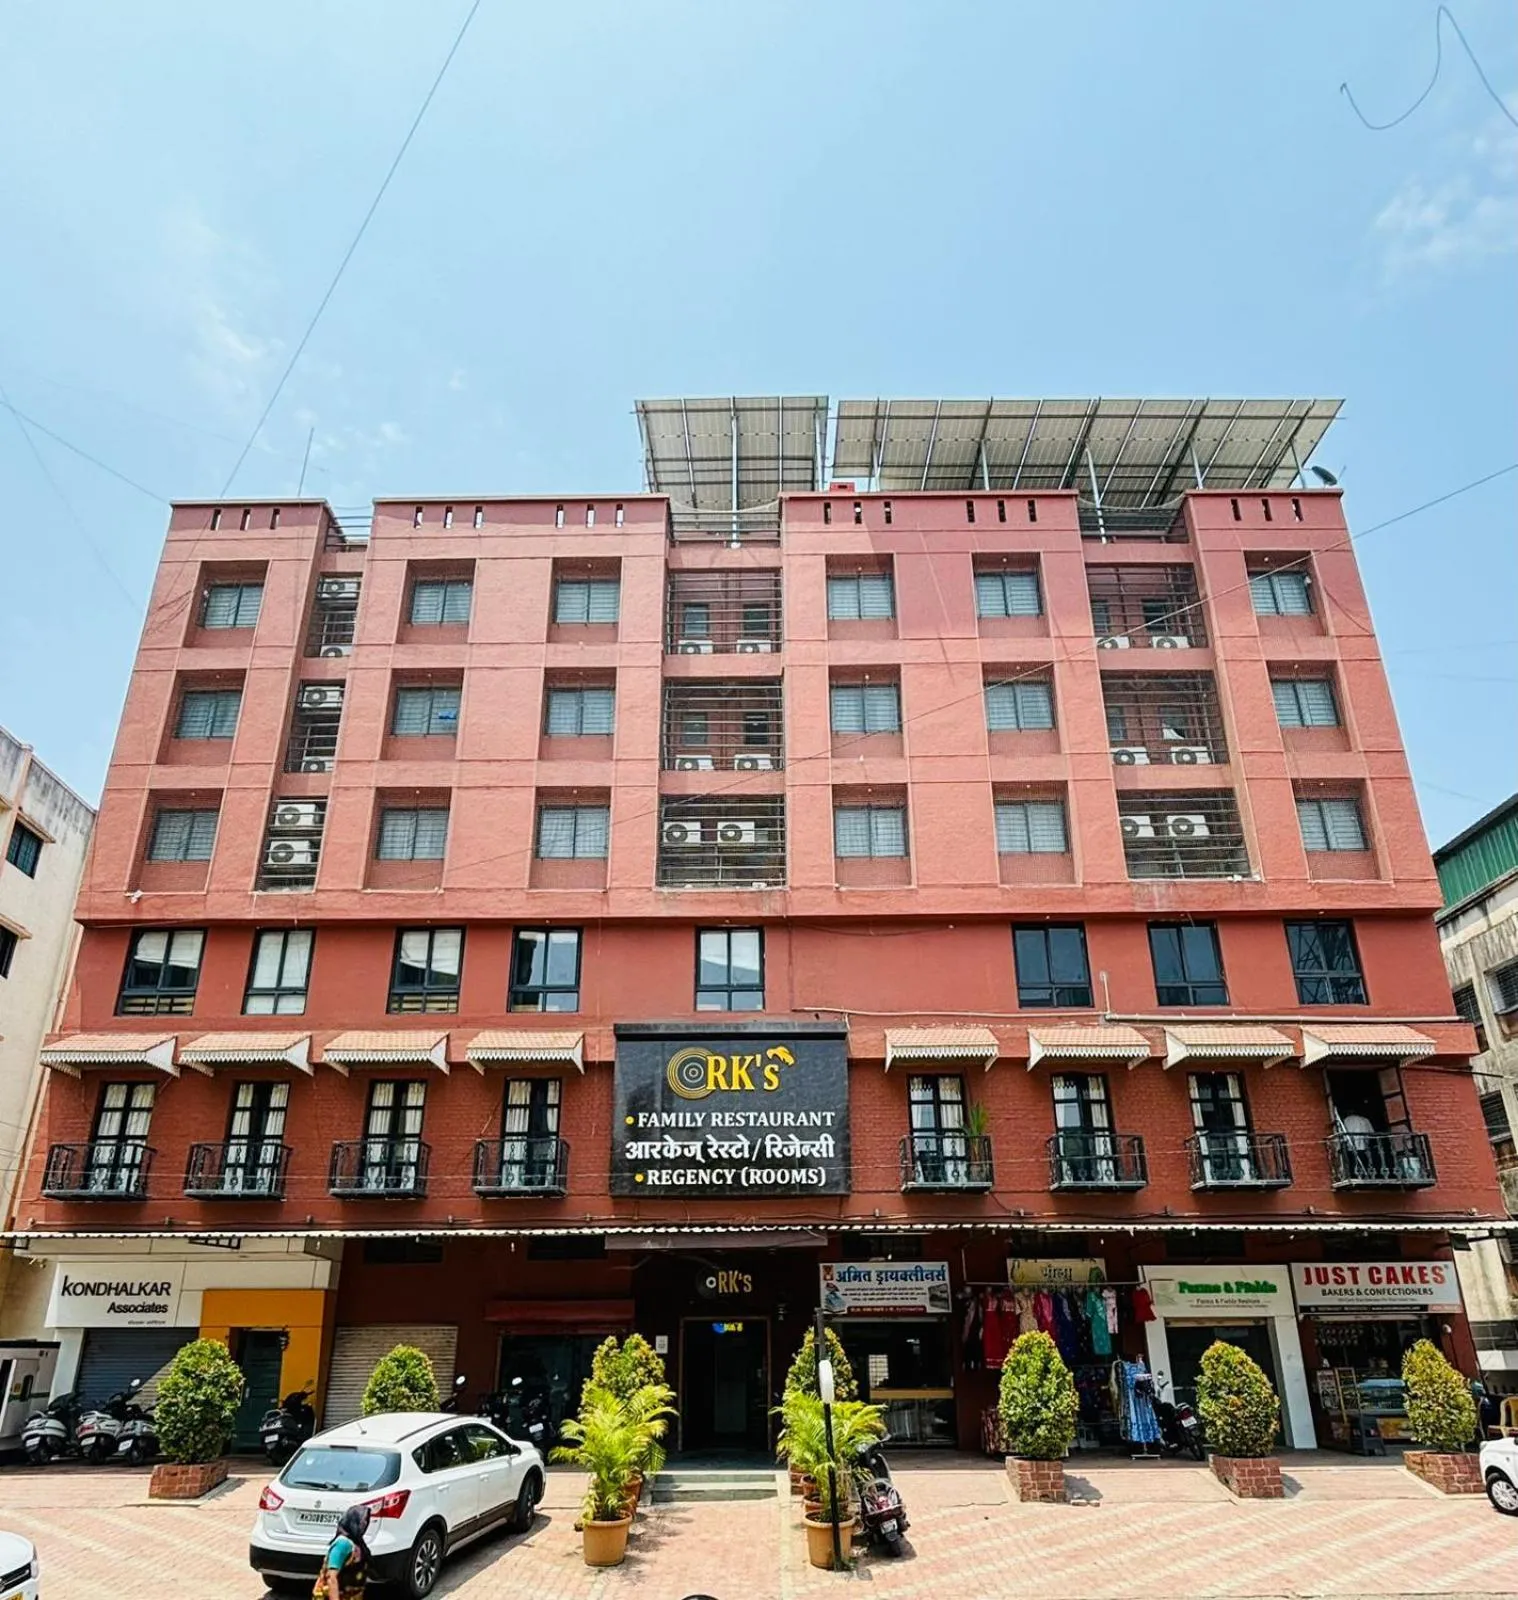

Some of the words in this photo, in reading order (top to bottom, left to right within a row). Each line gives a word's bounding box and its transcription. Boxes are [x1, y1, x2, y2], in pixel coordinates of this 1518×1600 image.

[637, 1112, 707, 1128] FAMILY
[710, 1112, 836, 1127] RESTAURANT
[624, 1134, 705, 1163] आरकेज्
[706, 1134, 751, 1159] रेस्टो
[764, 1132, 836, 1160] रिजेन्सी
[646, 1168, 736, 1185] REGENCY
[740, 1167, 827, 1187] (ROOMS)
[836, 1264, 872, 1283] अमित
[875, 1264, 947, 1285] ड्रायक्लीनर्स
[1303, 1266, 1361, 1286] JUST
[1368, 1265, 1447, 1285] CAKES
[1321, 1288, 1355, 1297] BAKERS
[1356, 1288, 1363, 1296] &
[1364, 1287, 1434, 1297] CONFECTIONERS
[107, 1301, 169, 1314] Associates
